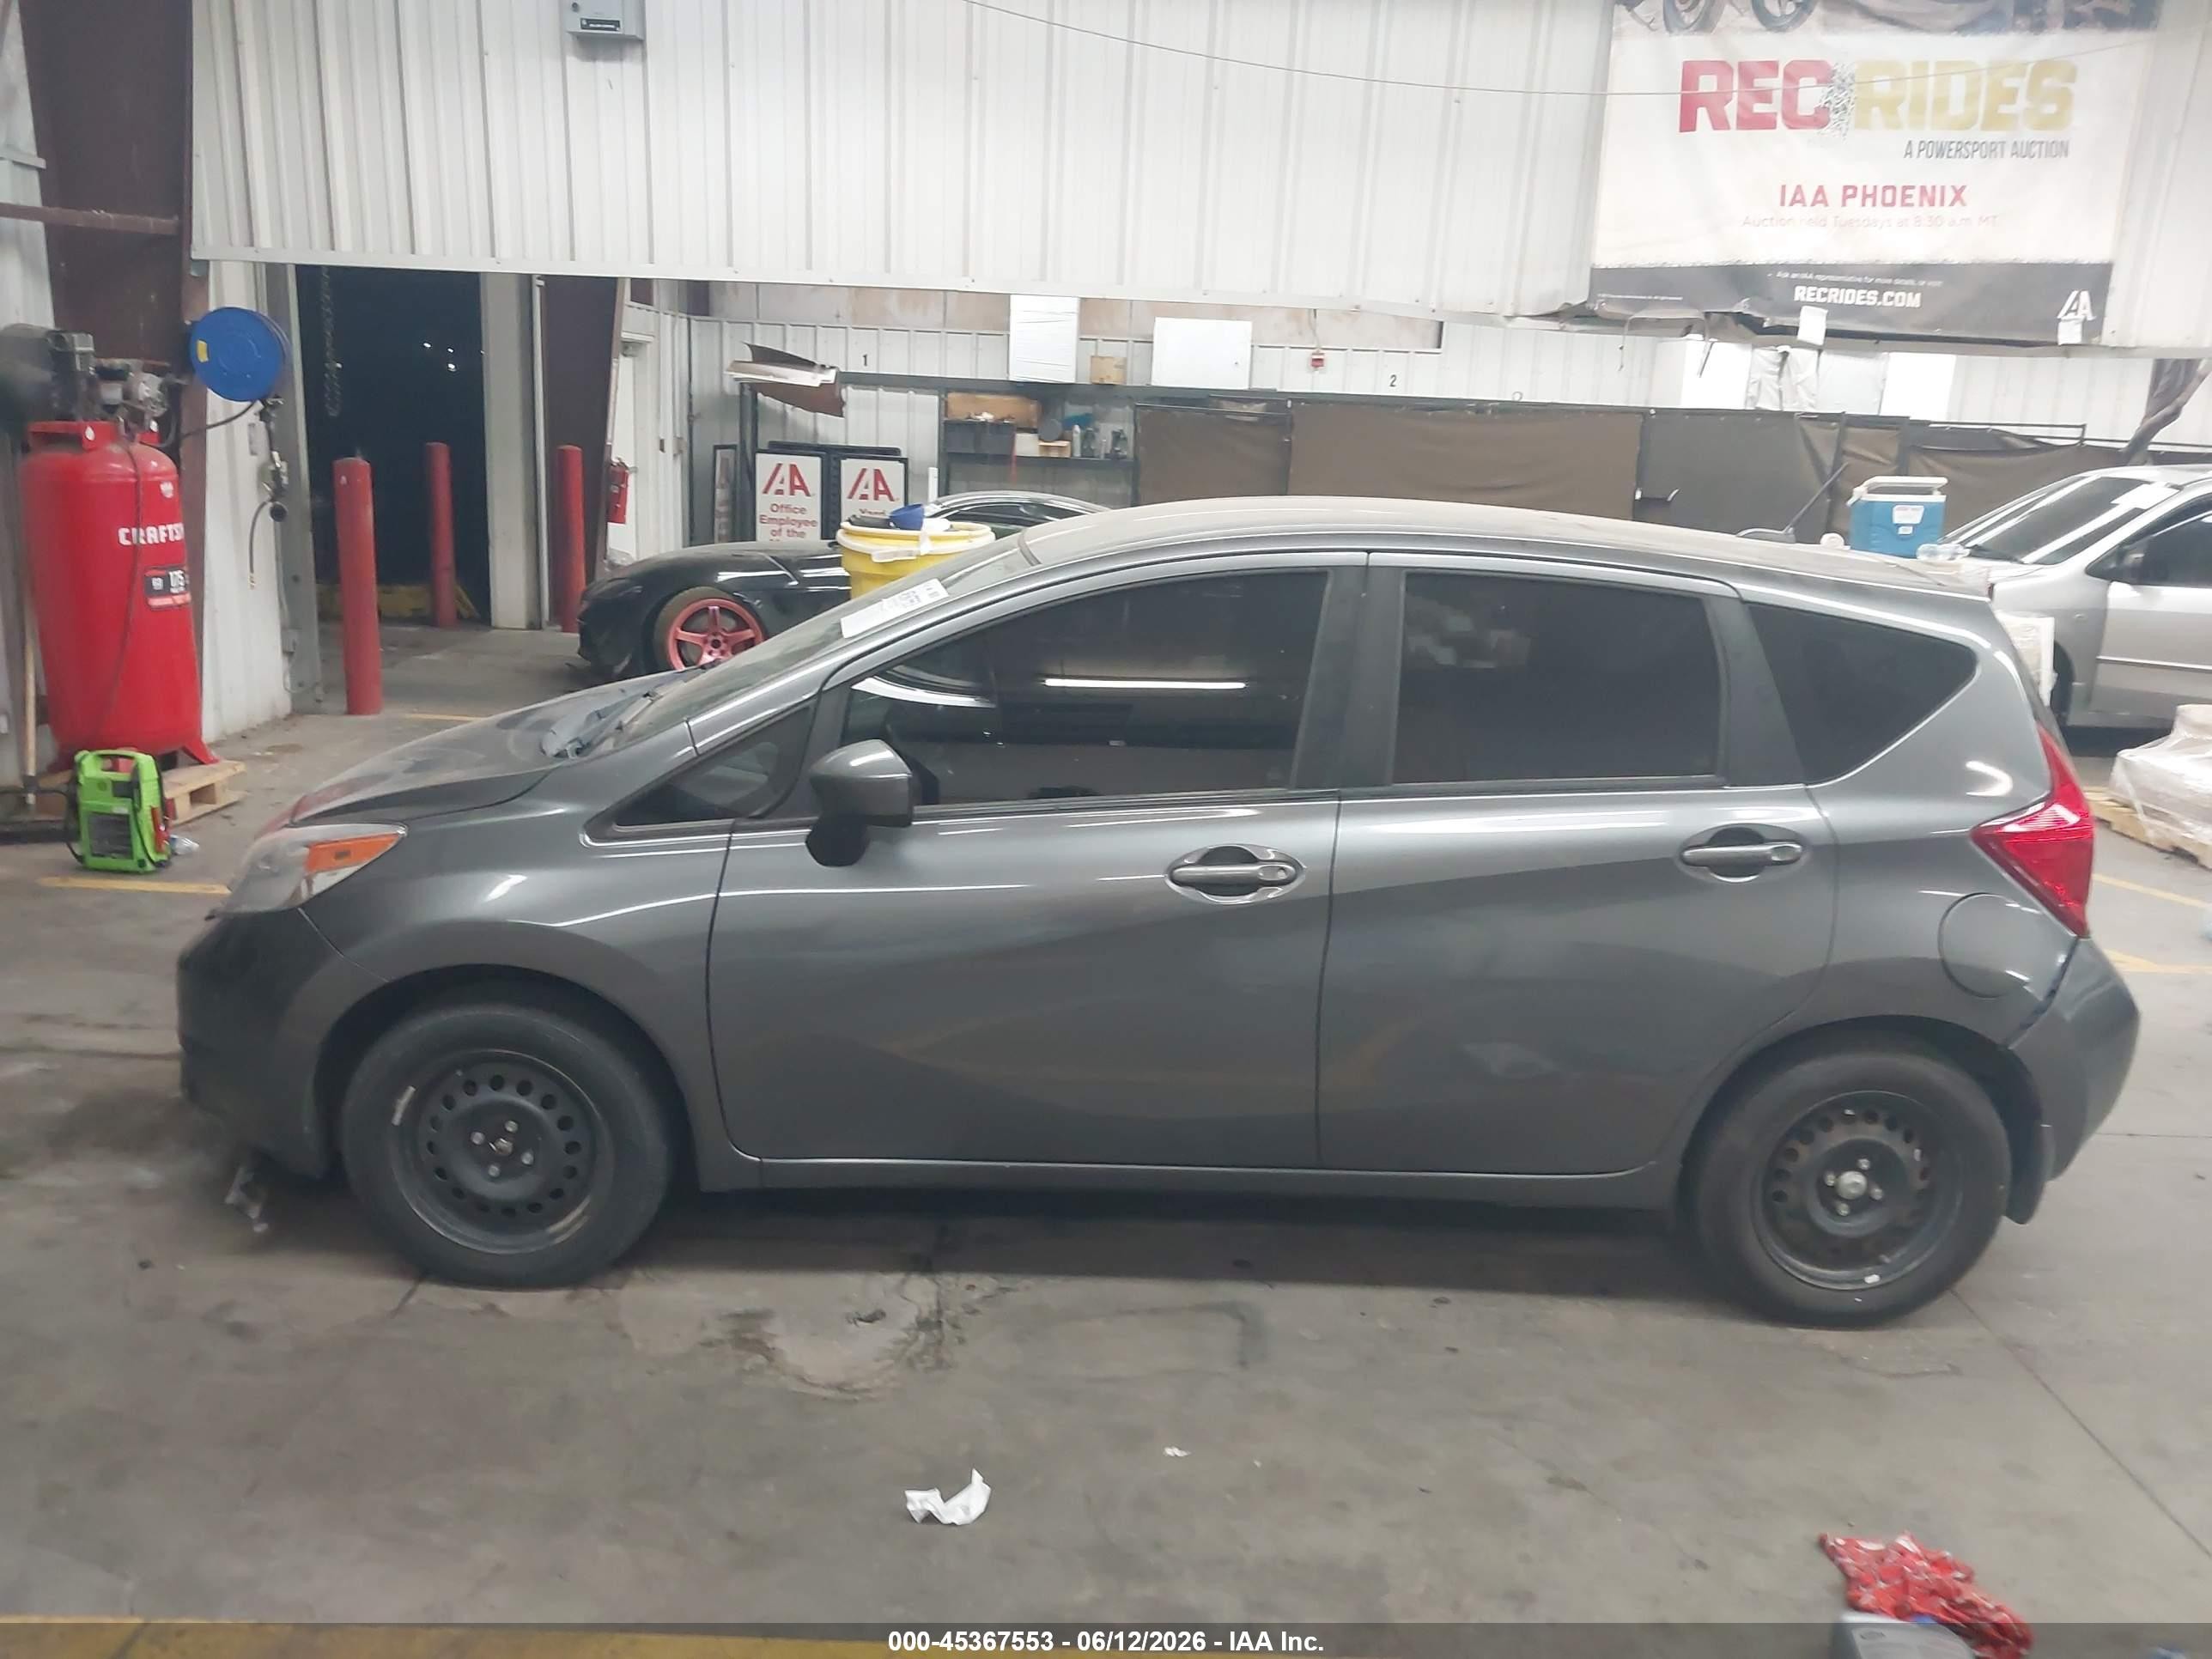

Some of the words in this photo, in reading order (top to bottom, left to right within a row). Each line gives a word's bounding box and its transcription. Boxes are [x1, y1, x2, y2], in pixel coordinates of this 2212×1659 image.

[1679, 59, 1836, 132] REC
[1854, 59, 2078, 131] RIDES
[1904, 140, 1913, 159] A
[1917, 140, 2006, 159] POWERSPORT
[2009, 140, 2070, 159] AUCTION
[1779, 184, 1829, 207] IAA
[1841, 185, 1967, 208] PHOENIX
[1794, 285, 1922, 308] RECRIDES.COM
[862, 353, 868, 367] 1
[1389, 374, 1397, 387] 2
[769, 502, 808, 515] Office
[759, 514, 818, 528] Employee
[770, 527, 783, 538] of
[786, 528, 806, 539] the
